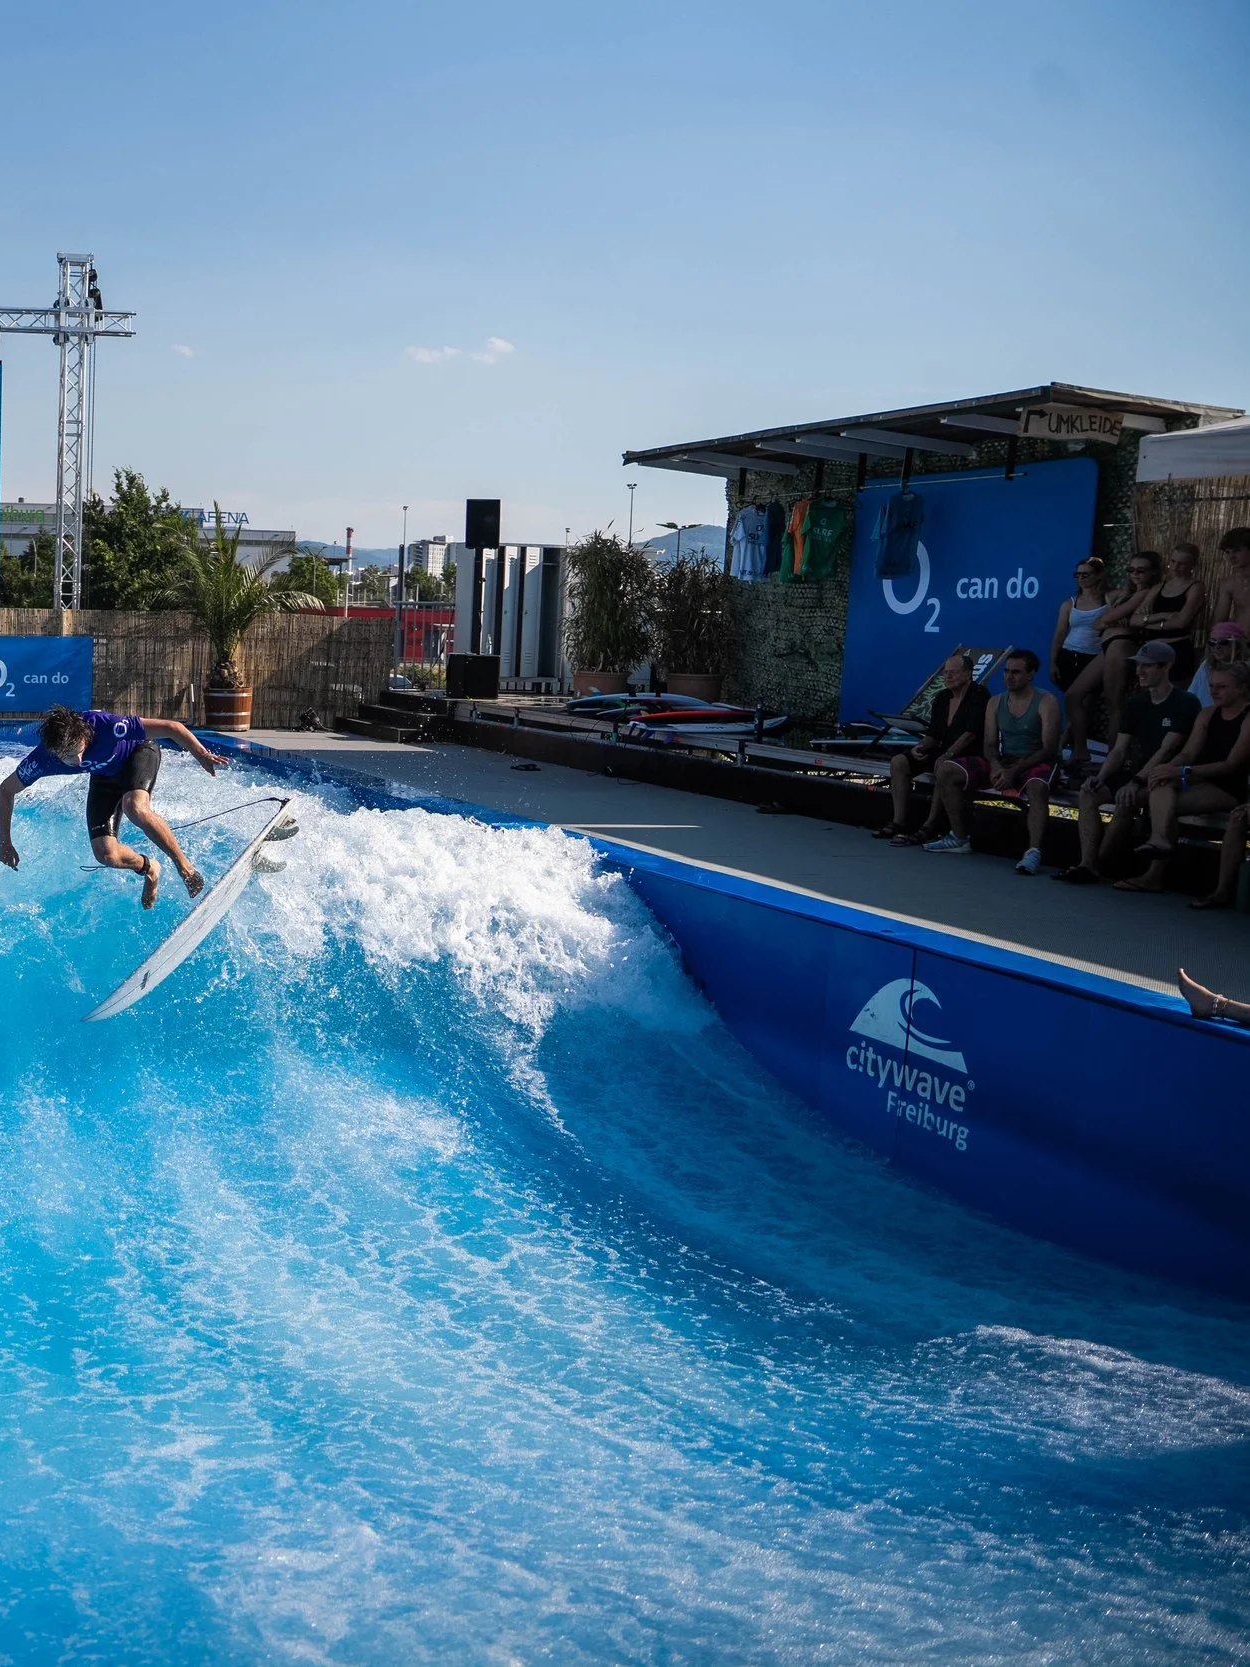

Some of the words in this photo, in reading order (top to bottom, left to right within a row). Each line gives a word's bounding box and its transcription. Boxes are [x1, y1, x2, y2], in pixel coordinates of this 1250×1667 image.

[1048, 412, 1123, 437] UMKLEIDE
[956, 577, 999, 599] can
[1006, 567, 1040, 599] do
[23, 674, 48, 684] can
[51, 671, 69, 684] do
[846, 1040, 966, 1112] citywave
[886, 1090, 969, 1151] Freiburg
